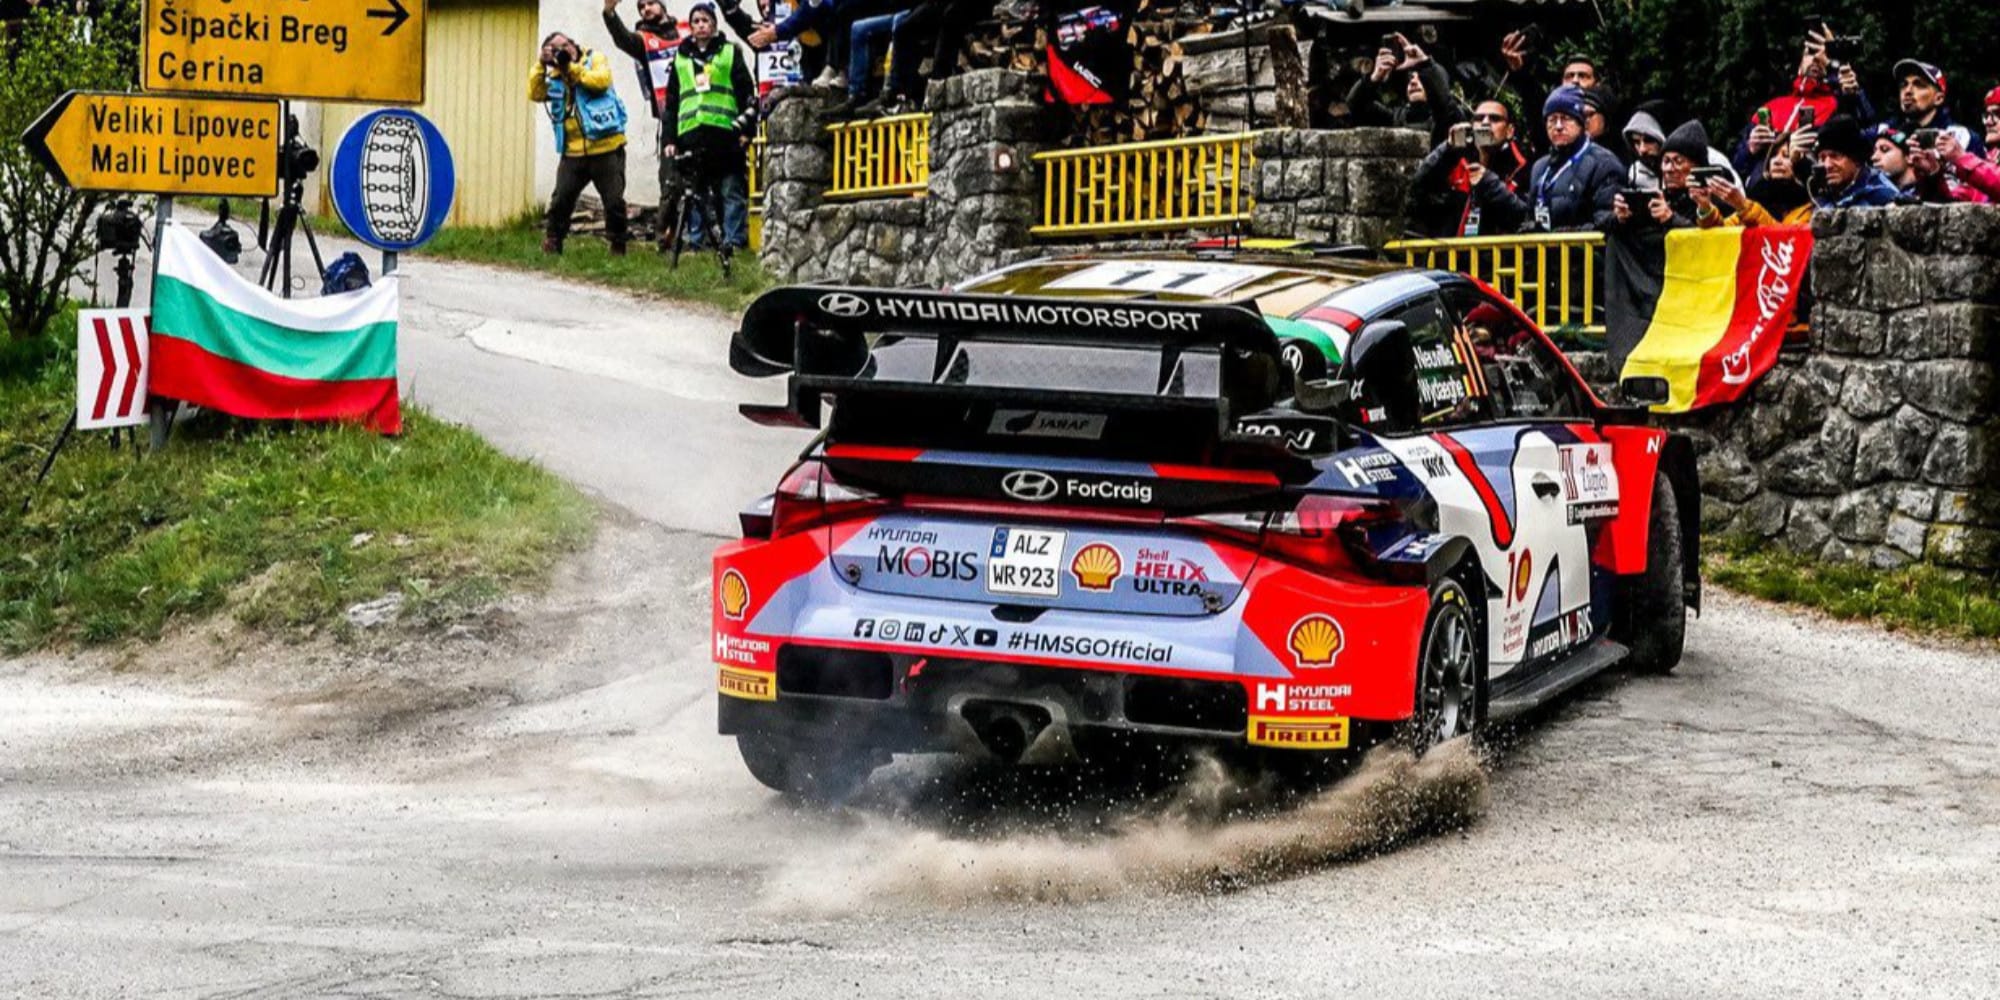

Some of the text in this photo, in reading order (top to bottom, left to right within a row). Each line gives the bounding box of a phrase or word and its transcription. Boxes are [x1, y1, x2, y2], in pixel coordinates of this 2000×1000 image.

[160, 0, 348, 53] Šipački Breg
[158, 51, 264, 85] Cerina
[91, 104, 271, 144] Veliki Lipovec
[91, 144, 256, 183] Mali Lipovec
[1110, 269, 1206, 288] 11
[876, 297, 1202, 331] HYUNDAI MOTORSPORT
[1721, 236, 1796, 384] Coca-Cola
[1413, 344, 1454, 368] Neuville
[1067, 479, 1152, 502] ForCraig
[868, 527, 938, 545] HYUNDAI
[1013, 535, 1051, 555] ALZ
[876, 545, 978, 581] MOBIS
[1137, 548, 1169, 561] Shell
[993, 565, 1055, 588] WR 923
[1134, 559, 1208, 582] HELIX
[1133, 578, 1204, 597] ULTRA
[728, 650, 756, 664] STEEL
[1007, 633, 1172, 662] #HMSGOfficial
[720, 669, 769, 695] PIRELLI
[1288, 685, 1352, 697] HYUNDAI
[1288, 698, 1335, 711] STEEL
[1257, 721, 1342, 741] PIRELLI
